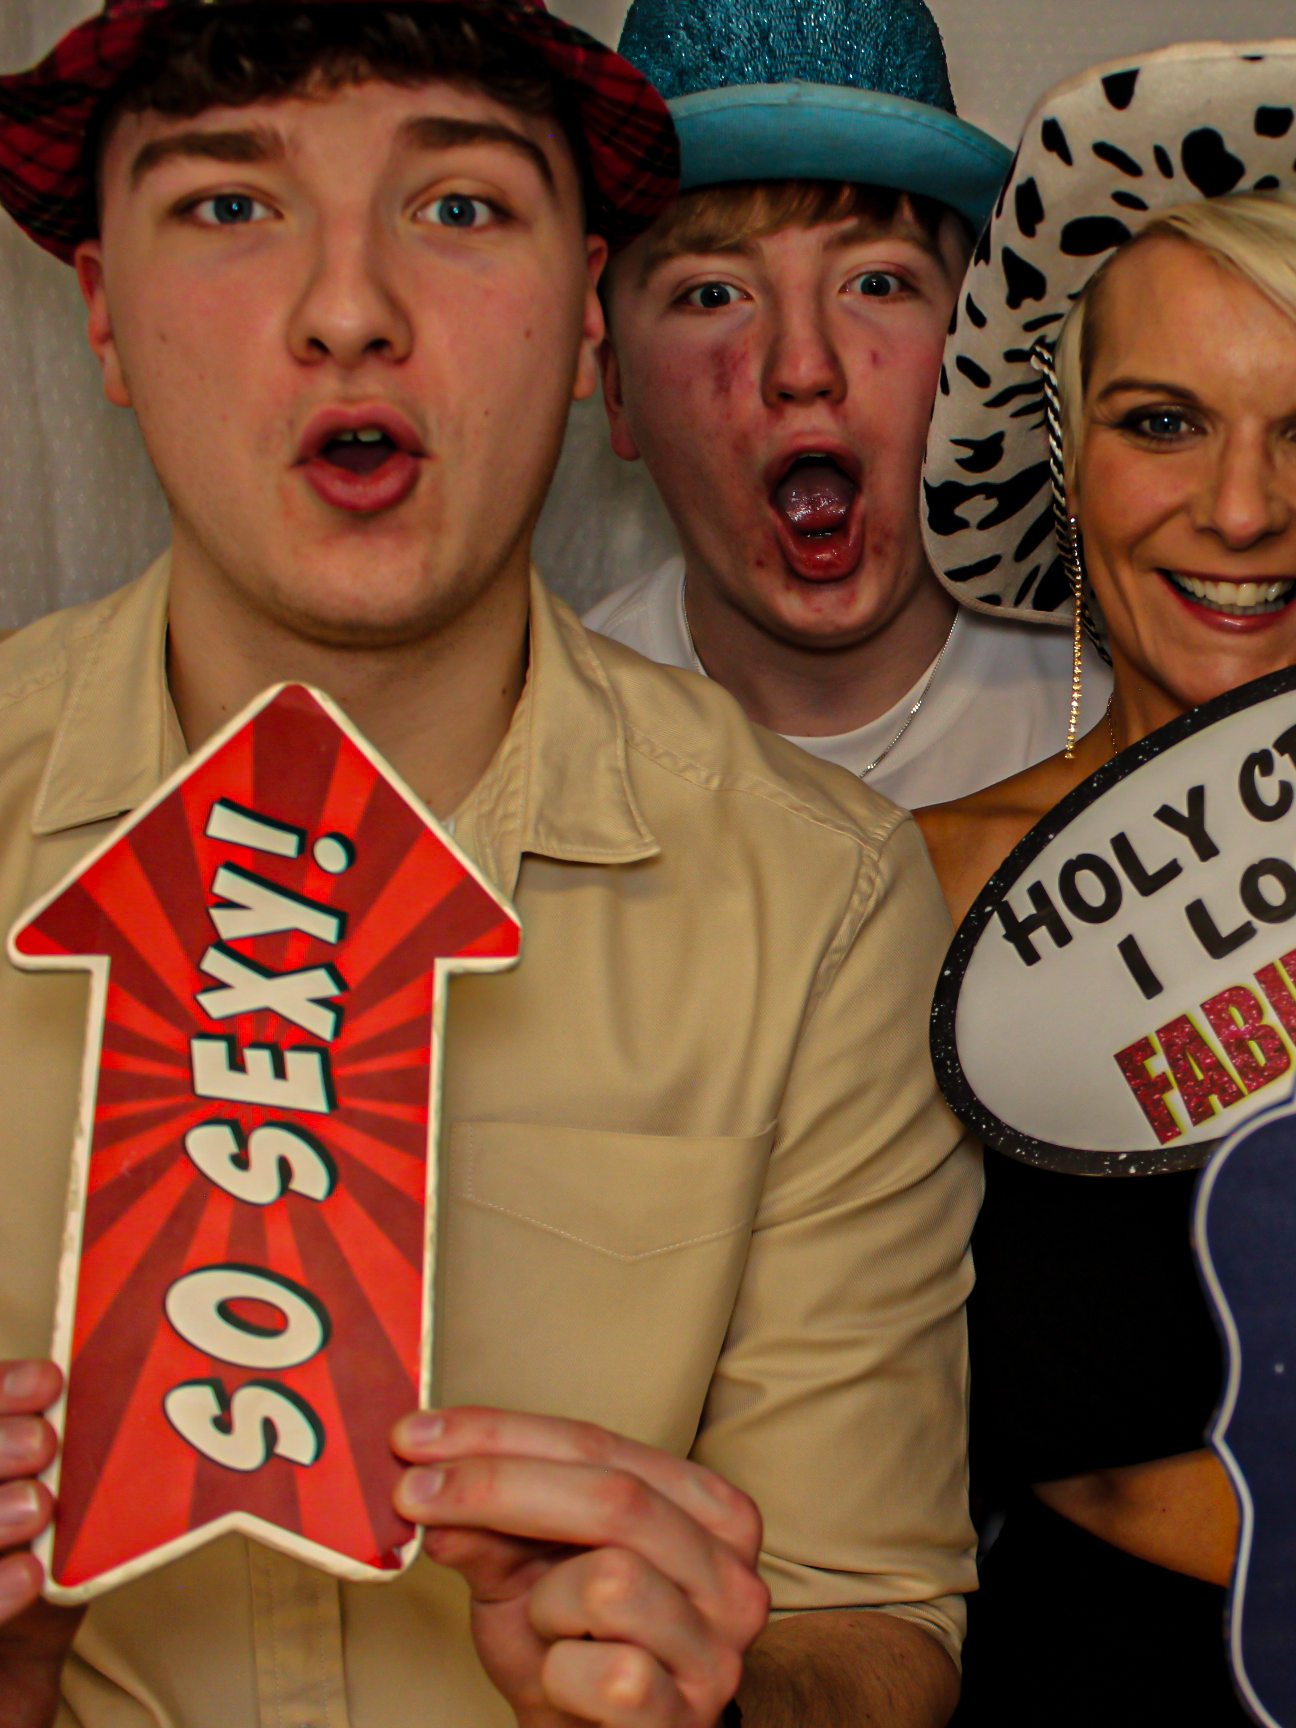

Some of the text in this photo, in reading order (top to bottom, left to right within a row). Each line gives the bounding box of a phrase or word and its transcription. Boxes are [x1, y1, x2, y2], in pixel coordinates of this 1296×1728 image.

[995, 785, 1220, 967] HOLY
[1117, 934, 1163, 1000] I
[163, 796, 357, 1472] SO SEXY!
